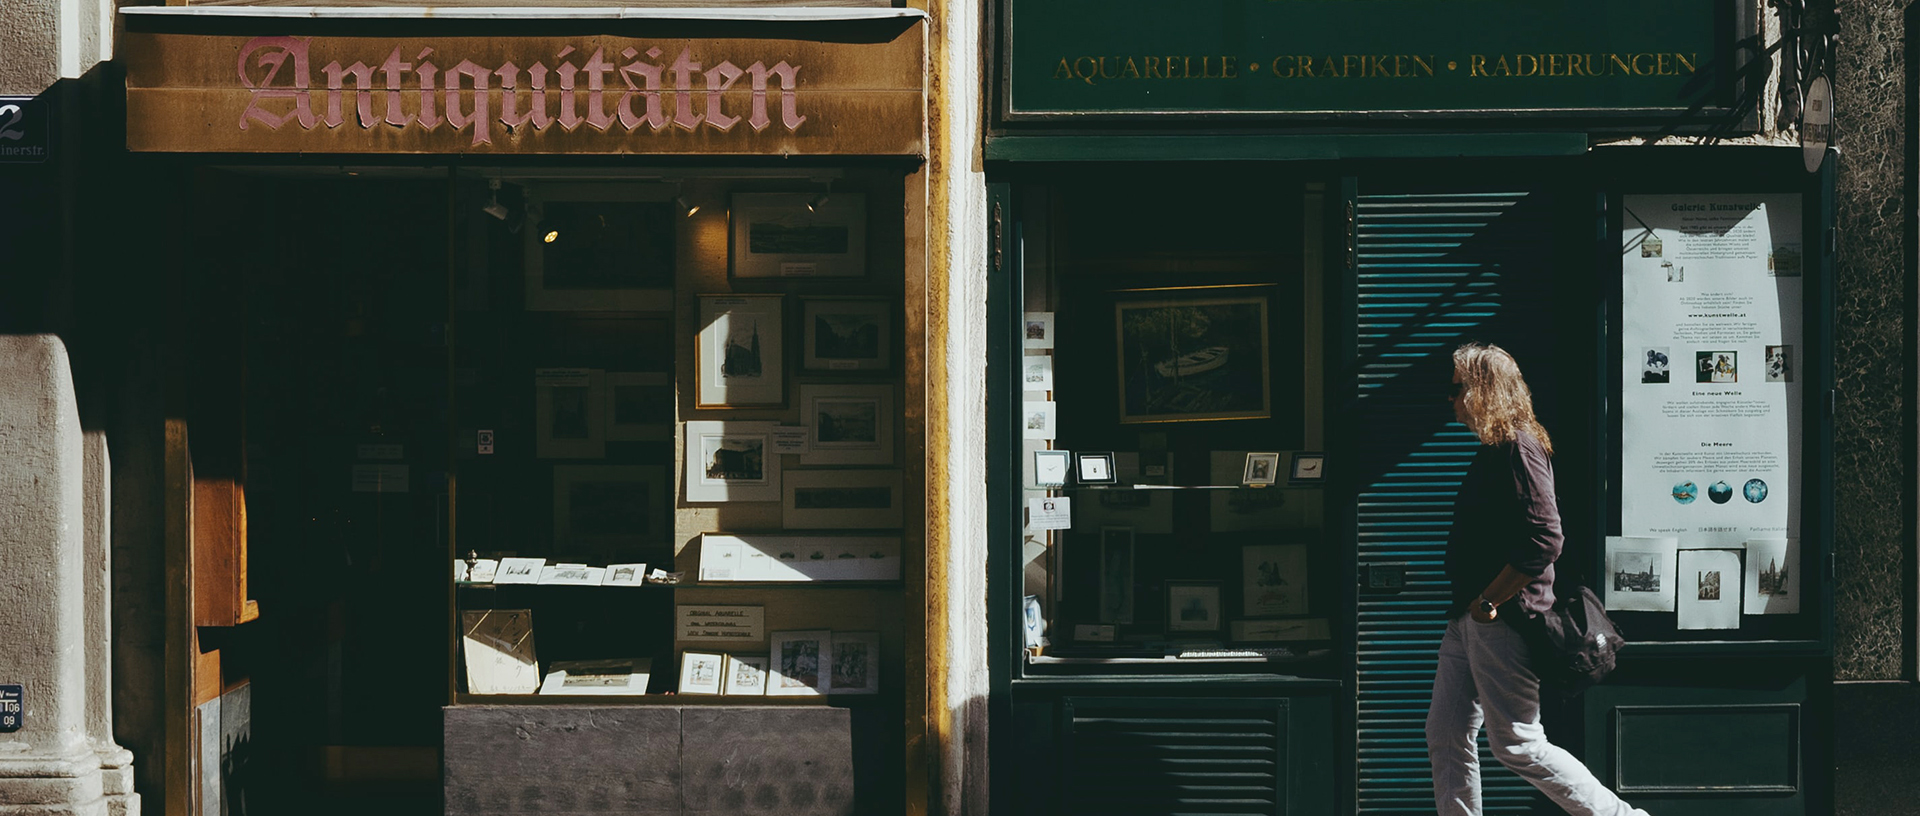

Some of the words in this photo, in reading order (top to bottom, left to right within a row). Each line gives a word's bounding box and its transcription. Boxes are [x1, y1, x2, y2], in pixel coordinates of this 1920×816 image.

[1053, 55, 1238, 85] AQUARELLE
[1272, 54, 1435, 78] GRAFIKEN
[1469, 52, 1697, 77] RADIERUNGEN
[237, 35, 807, 145] Antiquitäten
[0, 104, 24, 140] 2
[1671, 203, 1705, 211] Galerie
